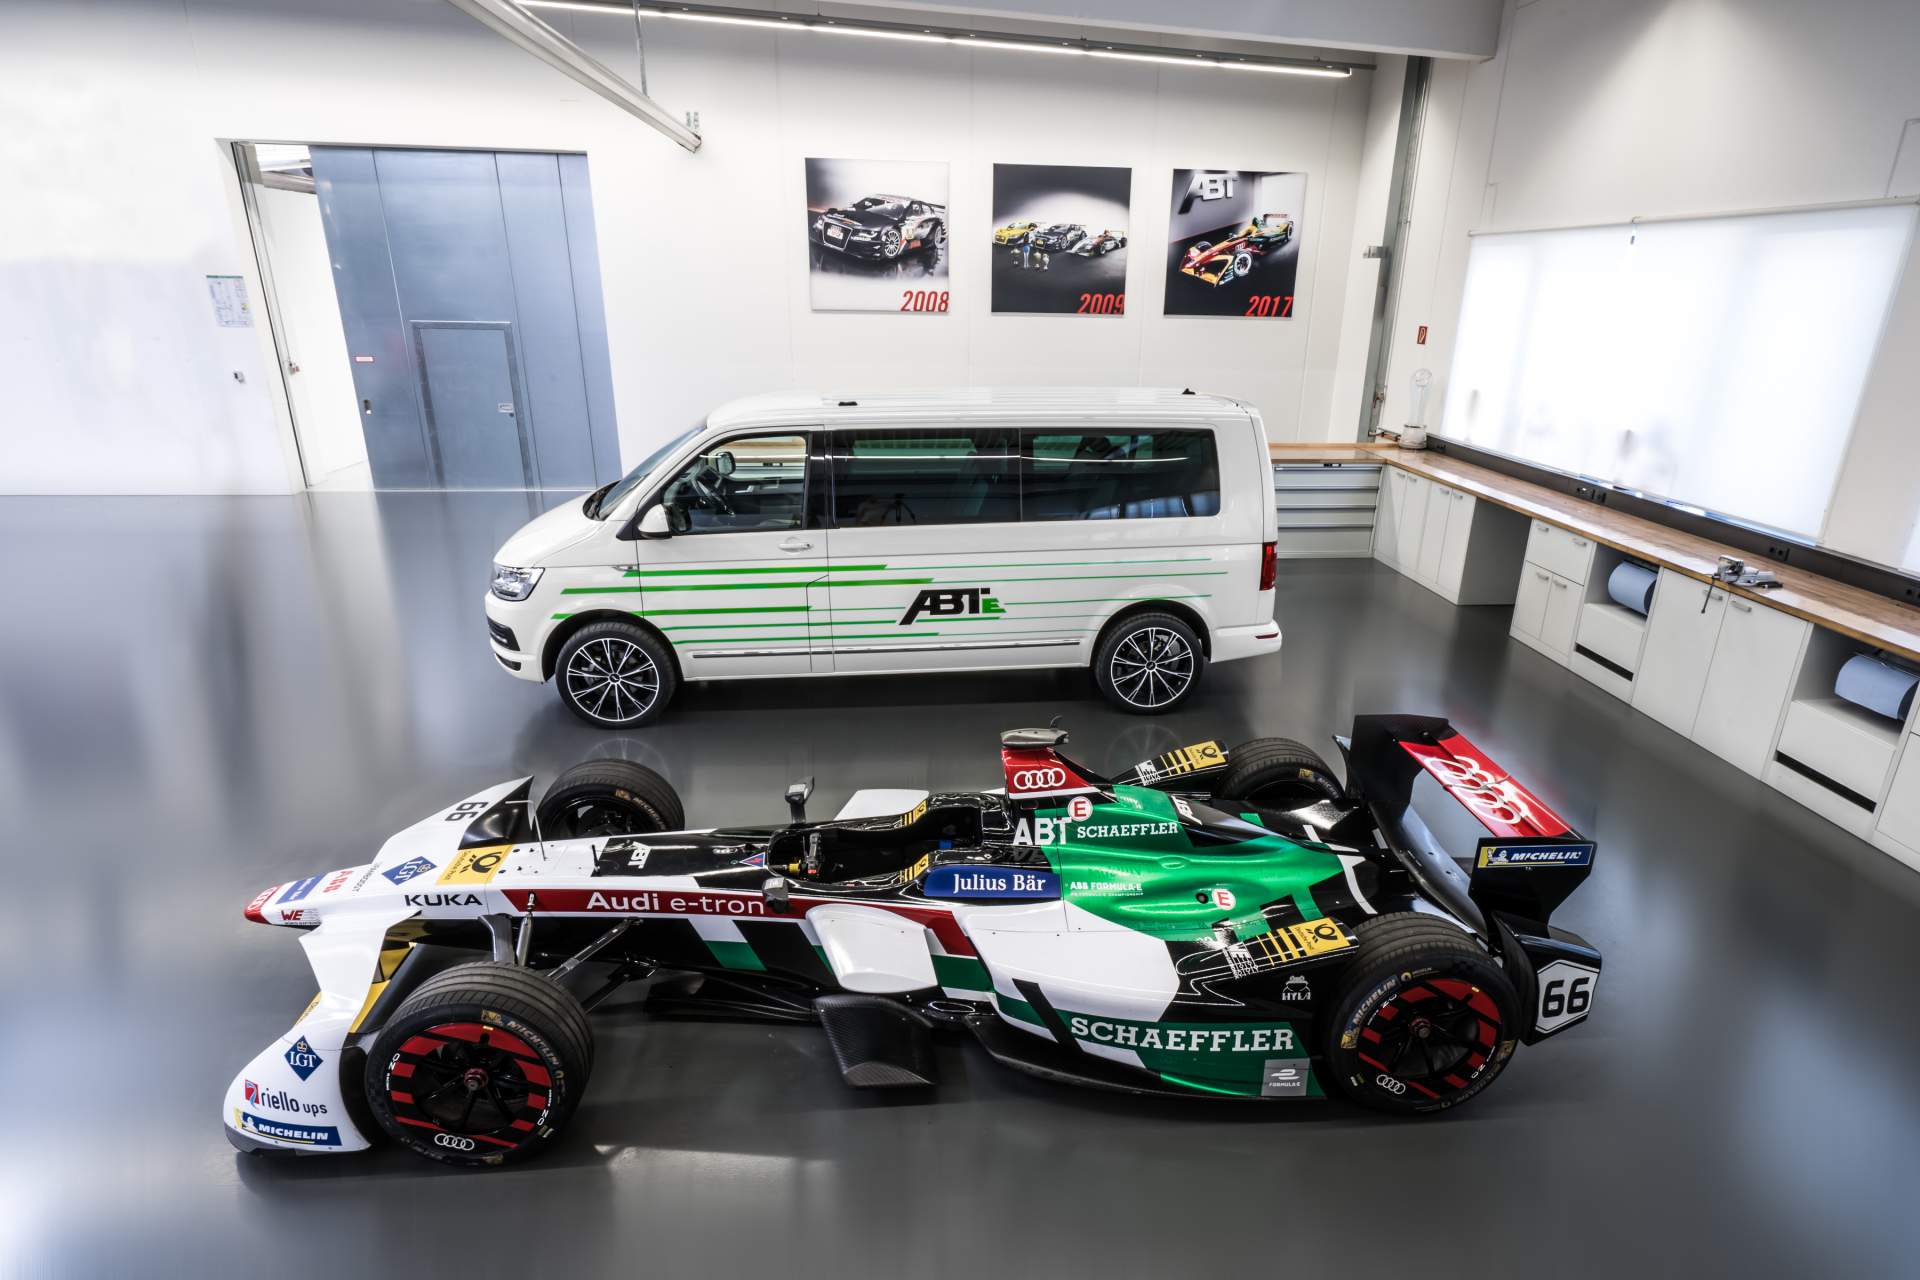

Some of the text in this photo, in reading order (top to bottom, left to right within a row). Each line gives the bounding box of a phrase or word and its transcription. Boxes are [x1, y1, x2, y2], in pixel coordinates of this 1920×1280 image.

[1178, 173, 1239, 215] ABT
[900, 290, 949, 312] 2008
[1077, 293, 1125, 315] 2009
[1244, 295, 1295, 318] 2017
[444, 801, 489, 822] 66
[1073, 800, 1087, 817] E
[1012, 816, 1179, 846] ABT SCHAEFFLER
[1510, 851, 1582, 861] MICHELIN
[953, 872, 1047, 895] Julius Bär
[404, 893, 483, 907] KUKA
[586, 891, 765, 915] Audi e-tron
[1216, 891, 1231, 907] E
[281, 909, 304, 921] WE
[1282, 991, 1312, 1001] HYLA
[1352, 978, 1397, 1025] MICHELIN
[1541, 976, 1591, 1019] 66
[1070, 1016, 1295, 1052] SCHAEFFLER
[289, 1053, 317, 1068] LGT
[260, 1088, 328, 1115] riello ups
[258, 1123, 329, 1142] MICHELIN
